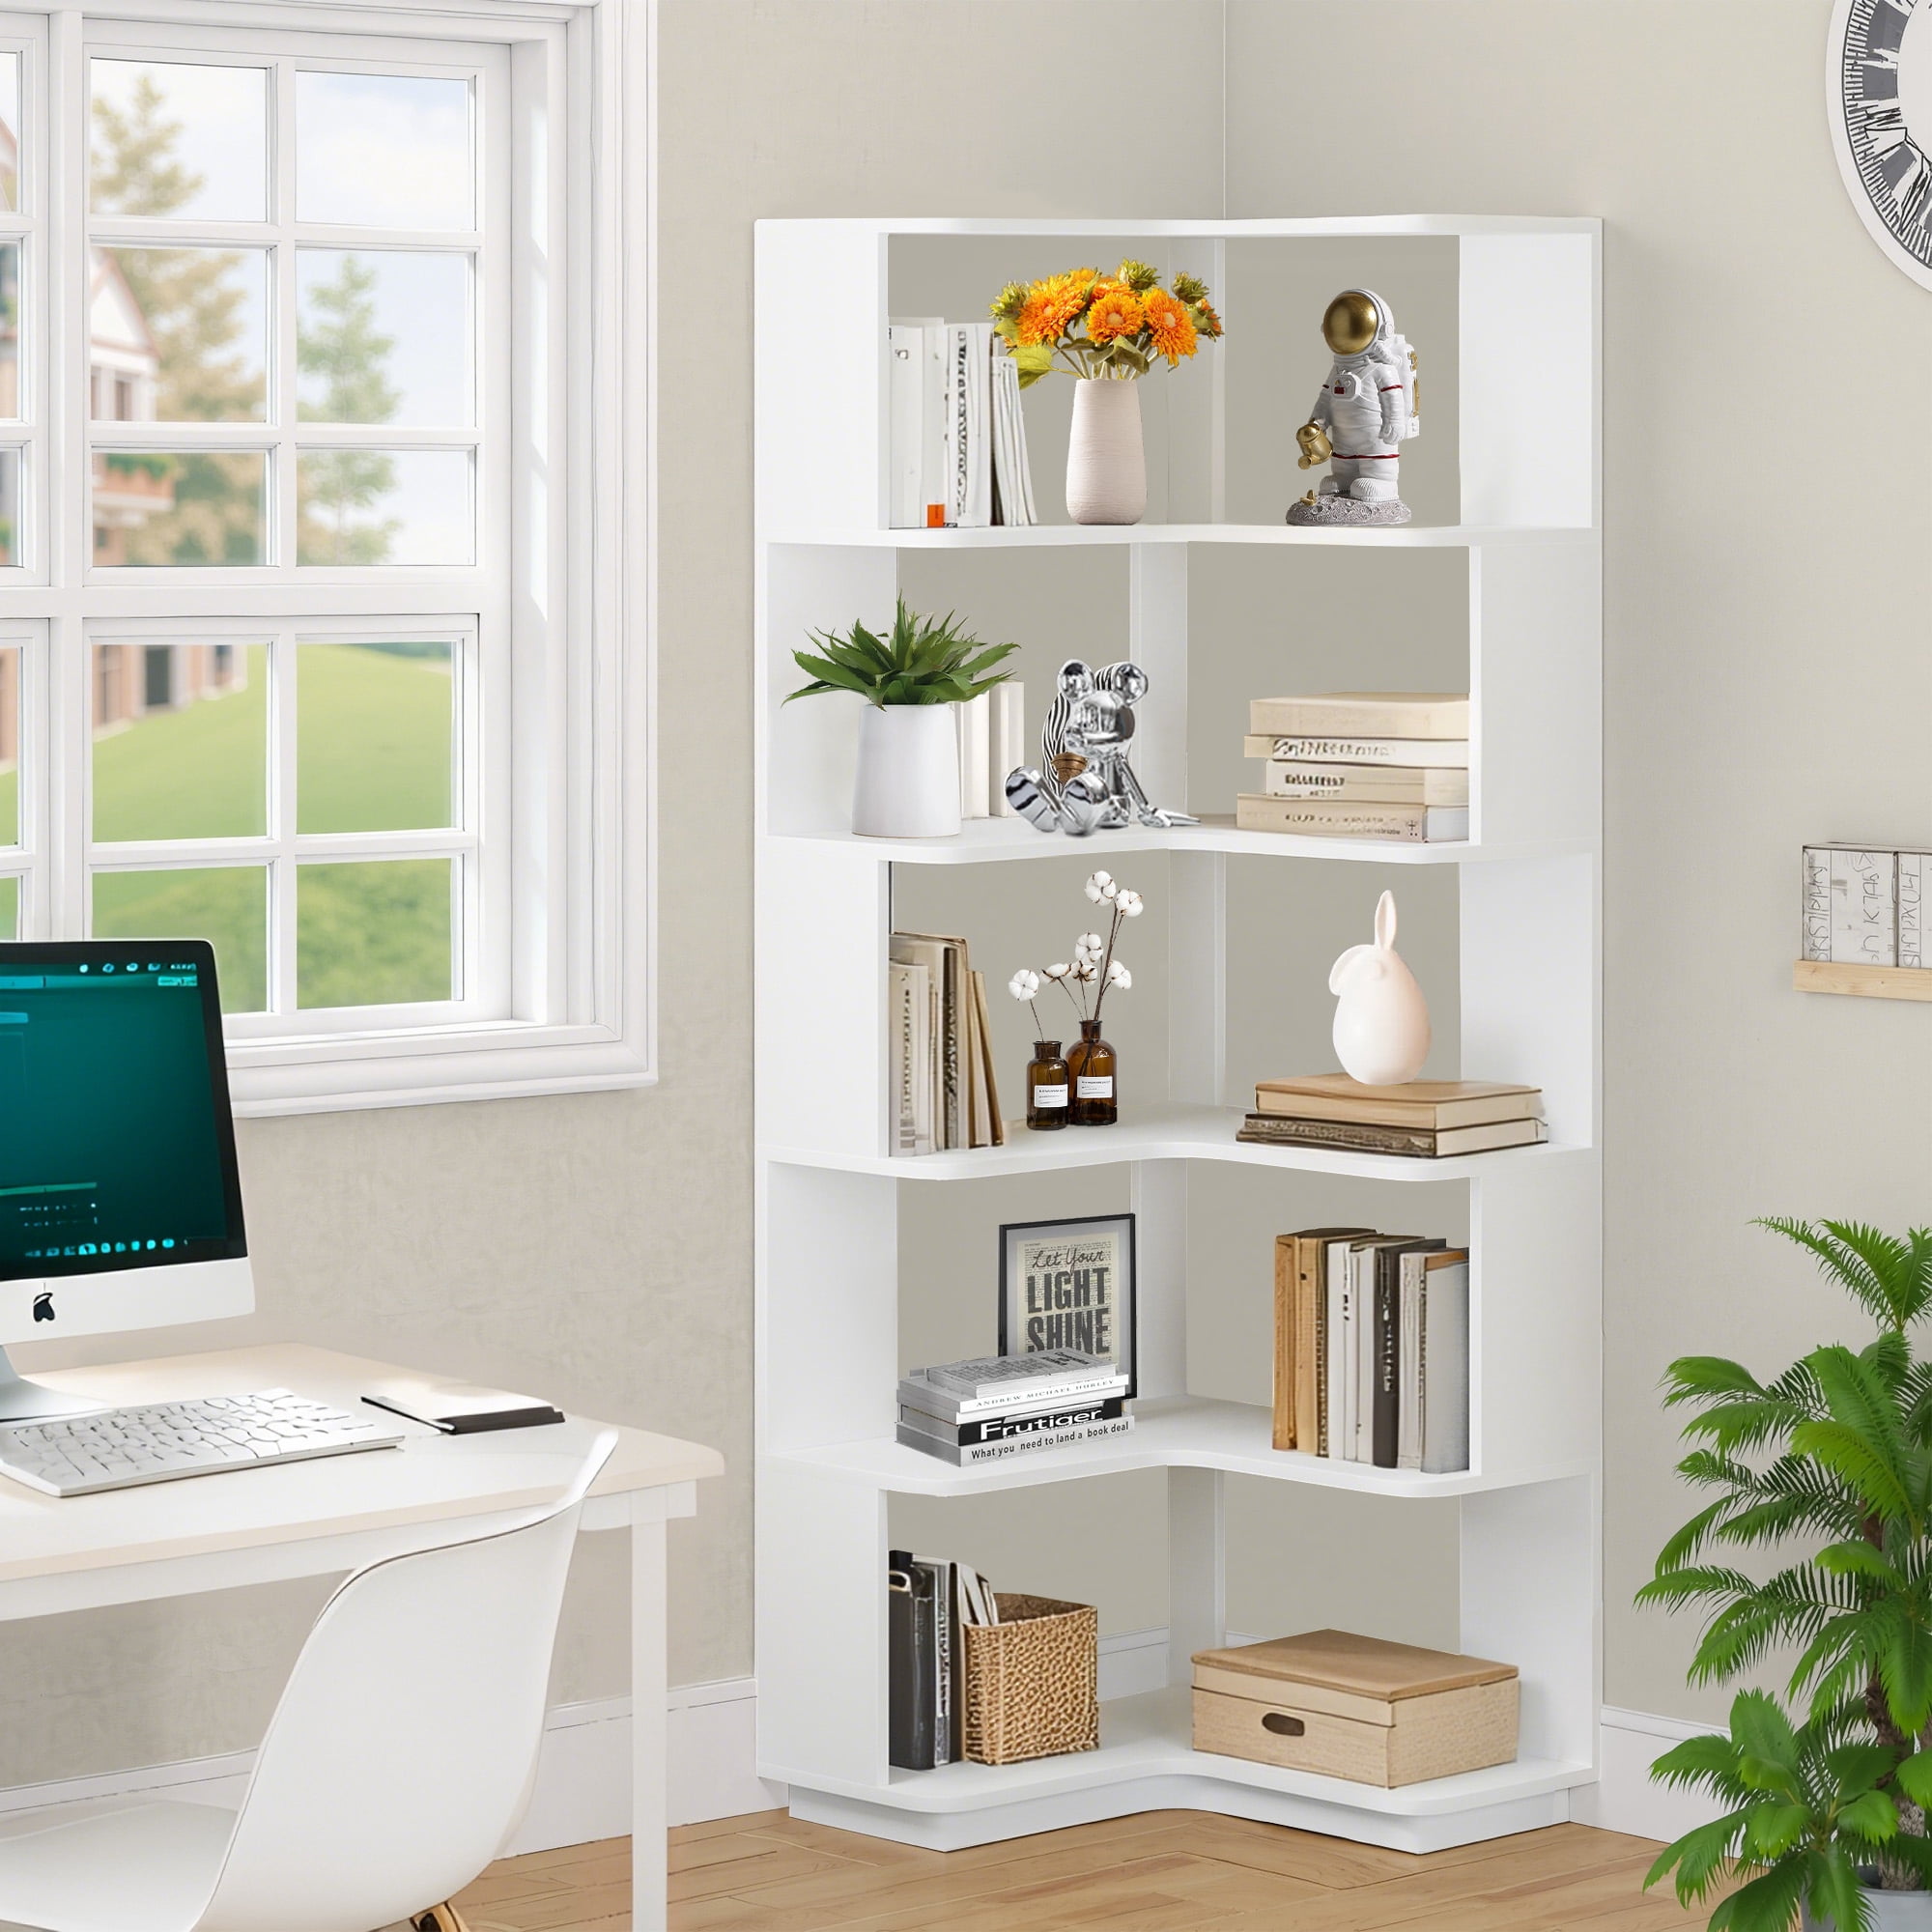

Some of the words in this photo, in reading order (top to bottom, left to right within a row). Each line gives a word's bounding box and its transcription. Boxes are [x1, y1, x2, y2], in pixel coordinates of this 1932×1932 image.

[1033, 1250, 1062, 1268] Let
[1066, 1248, 1104, 1275] Your
[1028, 1267, 1109, 1314] LIGHT
[1028, 1308, 1109, 1354] SHINE
[977, 1395, 1021, 1406] ANDREW
[1026, 1387, 1071, 1399] MICHAEL
[971, 1446, 995, 1460] What
[998, 1445, 1014, 1457] you
[1020, 1437, 1042, 1450] need
[1045, 1435, 1053, 1445] to
[1057, 1431, 1075, 1443] land
[1087, 1426, 1108, 1437] book
[1111, 1421, 1129, 1433] deal
[980, 1408, 1102, 1440] Frutiger
